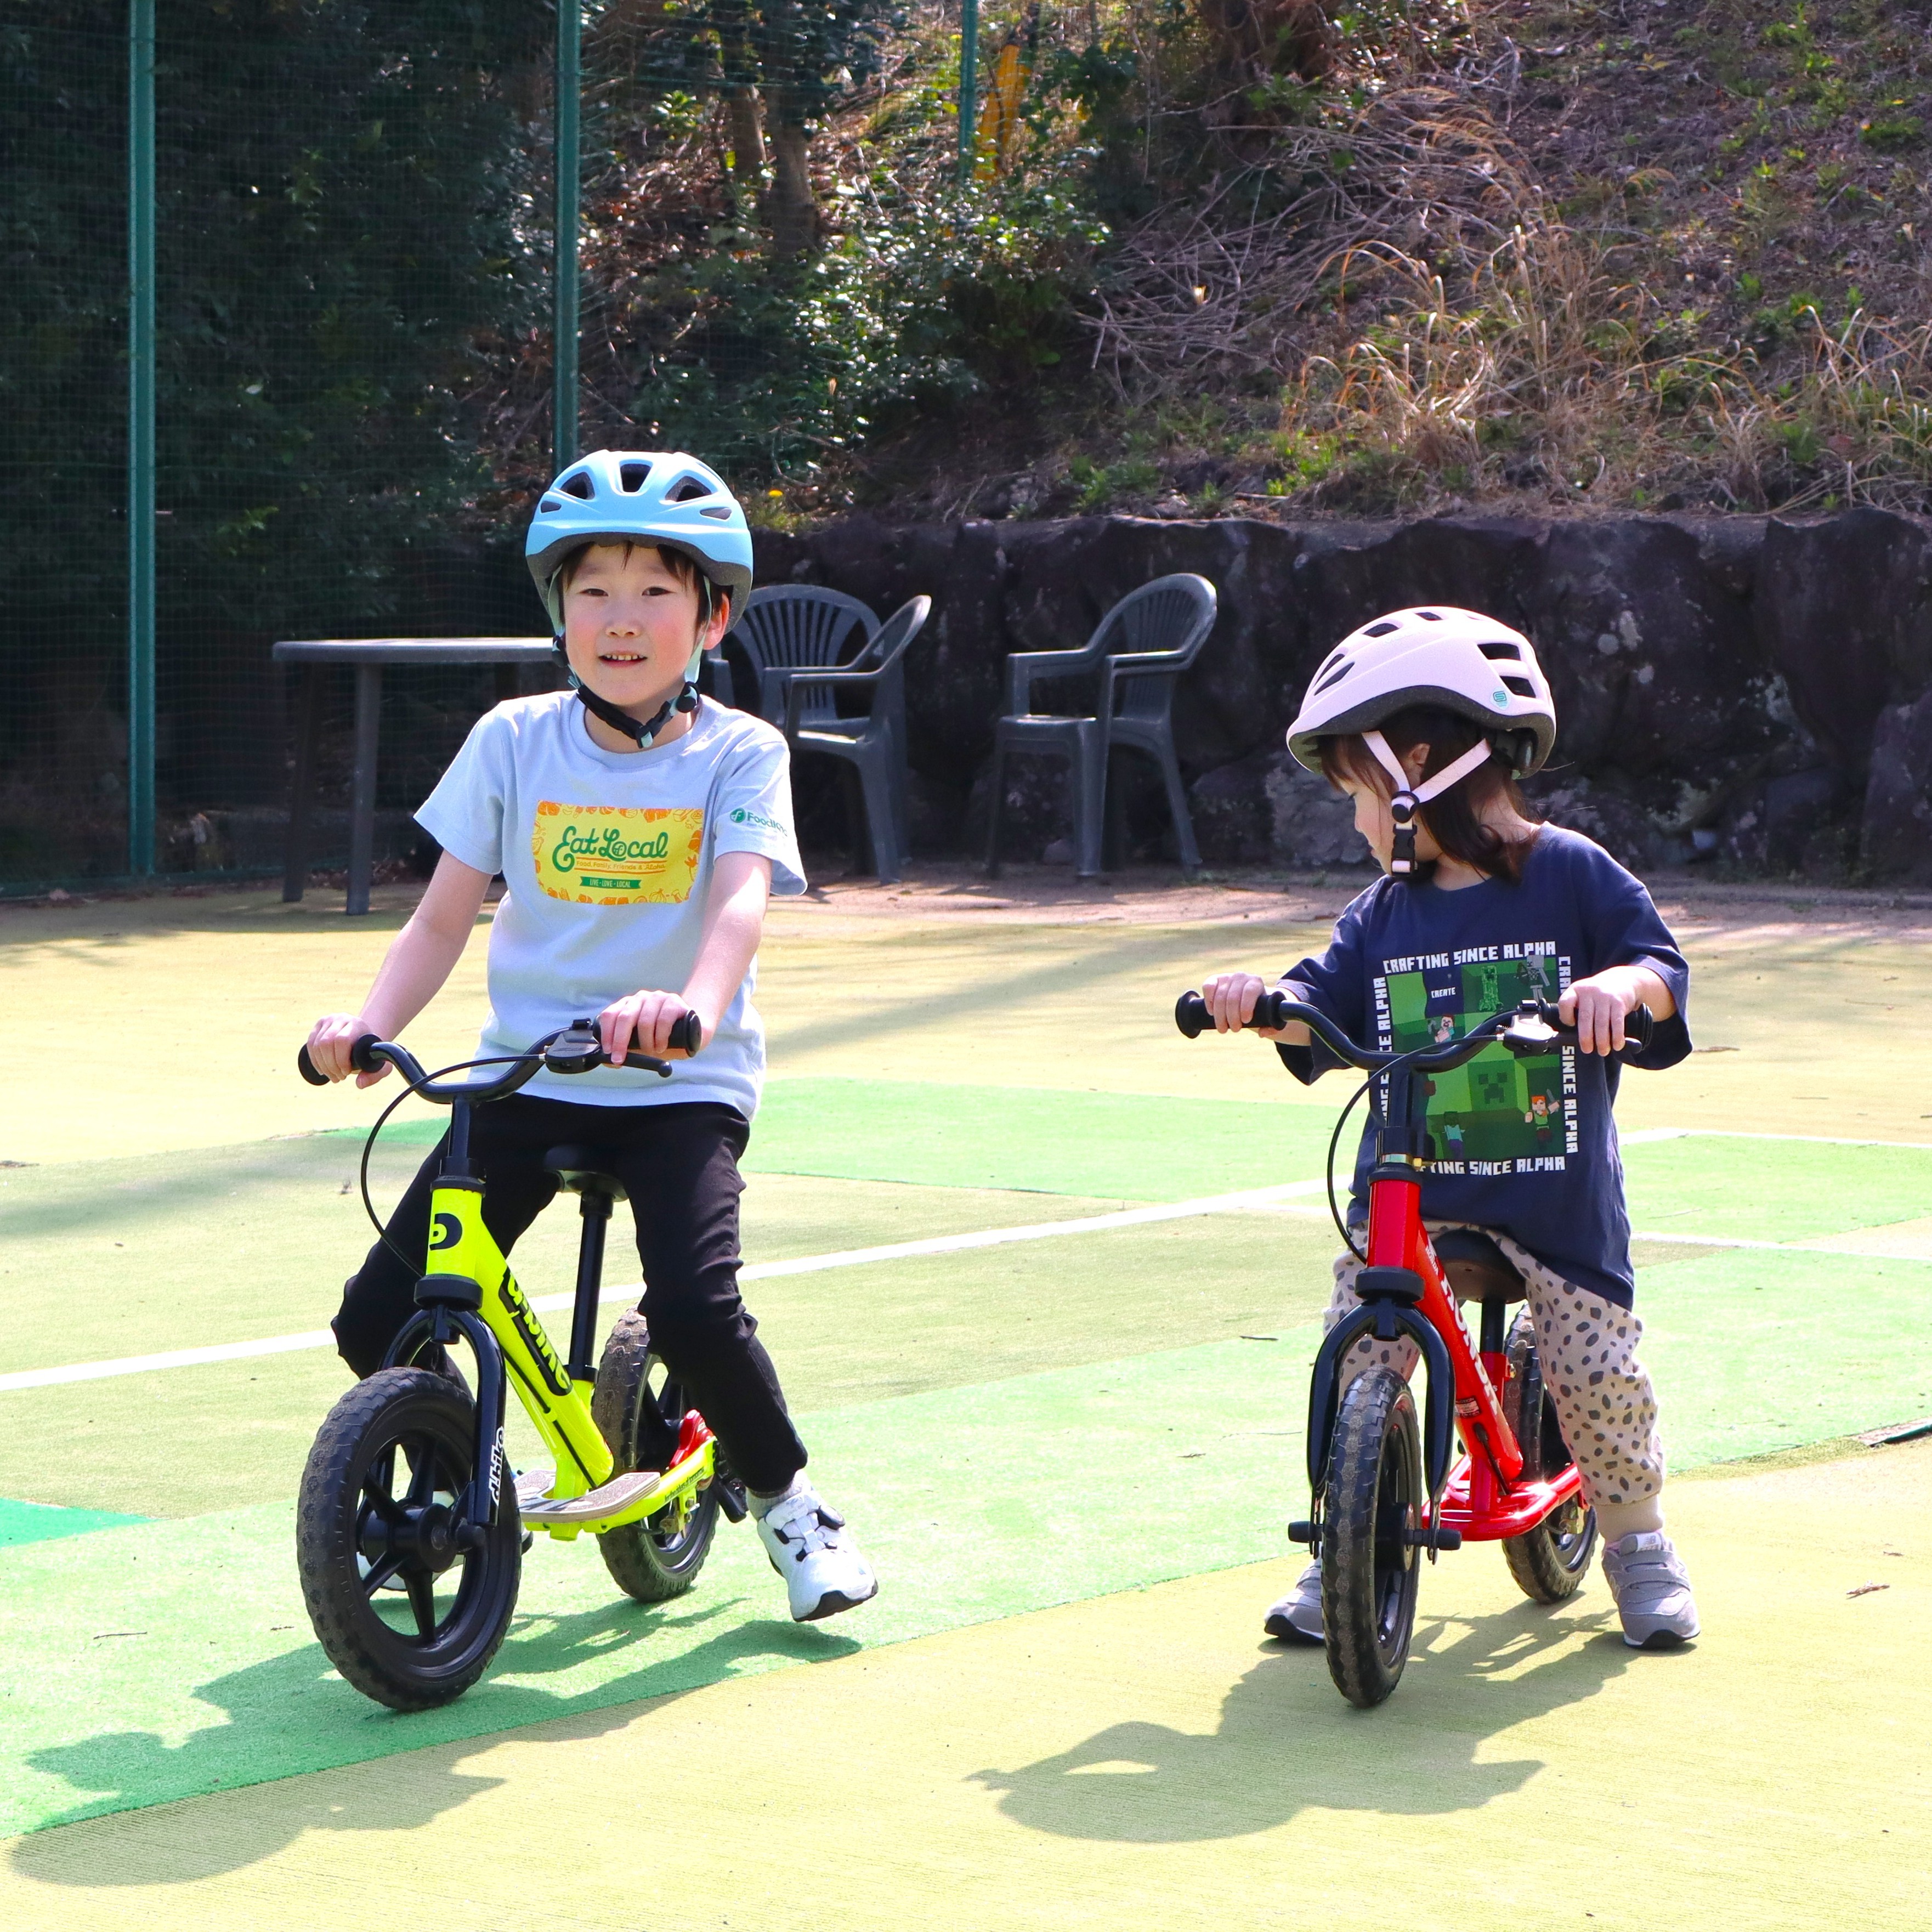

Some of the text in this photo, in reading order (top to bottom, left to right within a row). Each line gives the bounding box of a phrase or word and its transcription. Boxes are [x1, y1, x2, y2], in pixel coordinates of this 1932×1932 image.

[552, 825, 668, 872] Eat Local
[1383, 941, 1556, 974] CRAFTING SINCE ALPHA
[1373, 977, 1391, 1031] ALPHA
[1431, 987, 1456, 999] CREATE
[1562, 1045, 1578, 1154] SINCE ALPHA
[1469, 1160, 1511, 1176] SINCE
[1516, 1156, 1565, 1172] ALPHA
